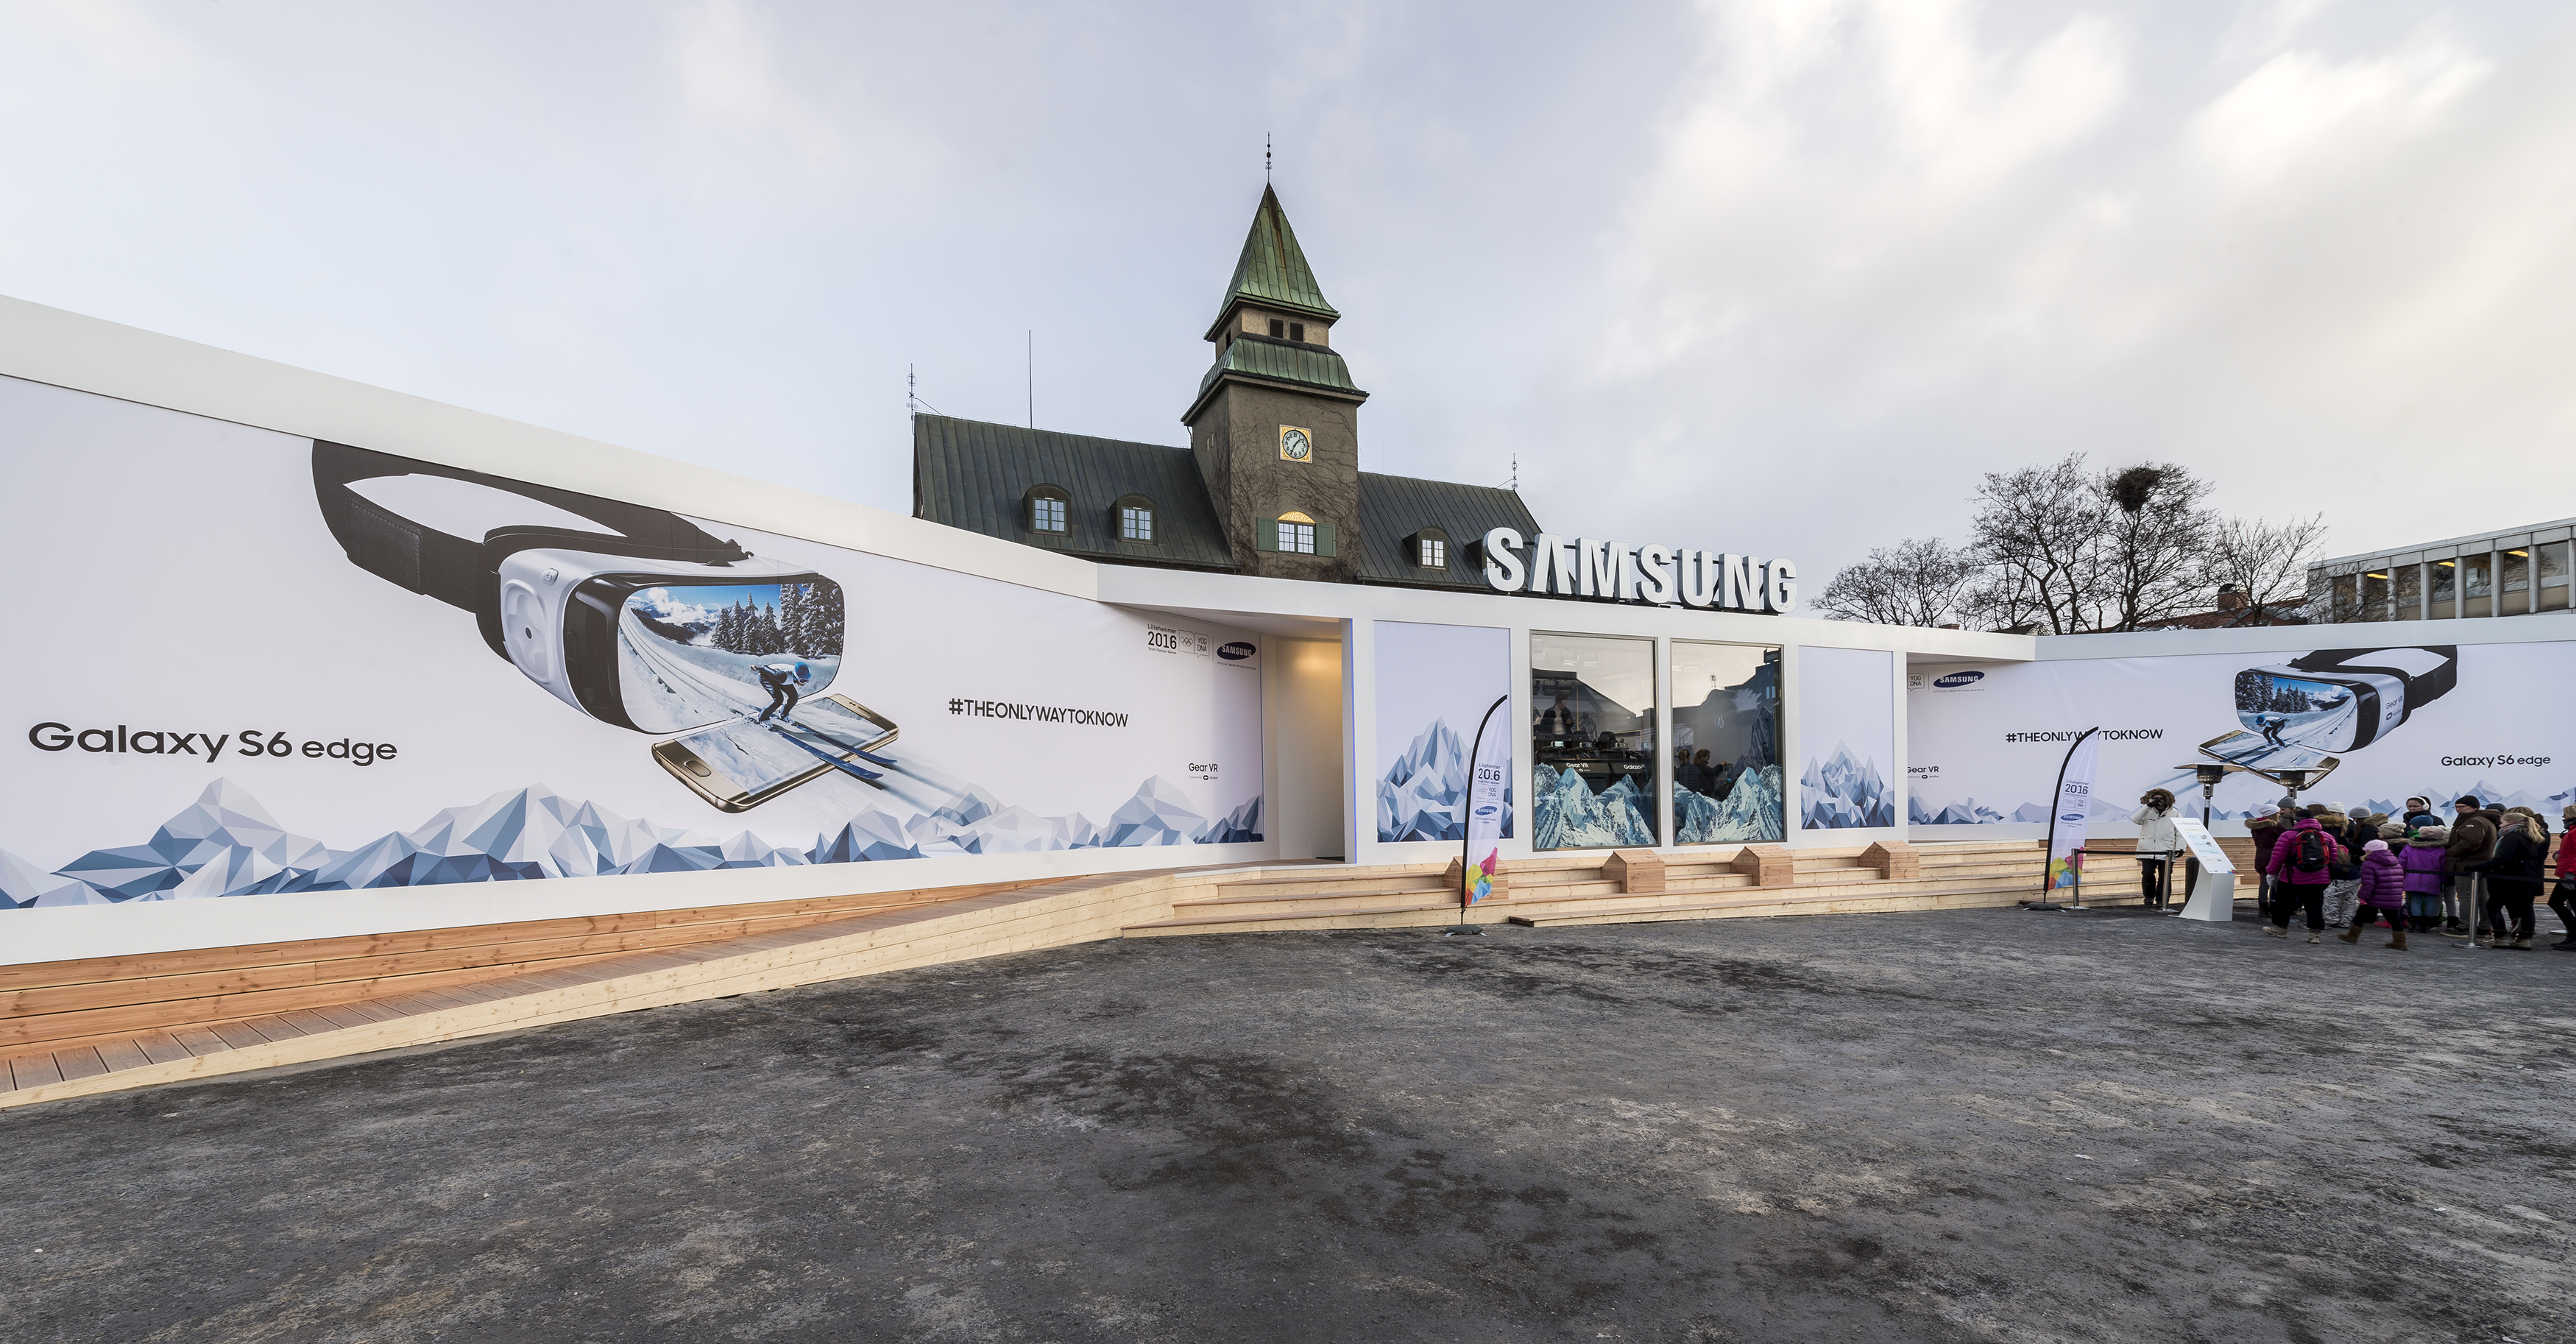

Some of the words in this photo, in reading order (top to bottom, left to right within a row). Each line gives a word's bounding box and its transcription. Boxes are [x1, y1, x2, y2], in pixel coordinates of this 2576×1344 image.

[1483, 527, 1797, 613] SAMSUNG
[1147, 623, 1176, 634] Lillehammer
[1147, 631, 1177, 649] 2016
[1197, 637, 1207, 645] YOG
[1197, 644, 1207, 652] DNA
[1221, 645, 1252, 657] SAMSUNG
[949, 698, 1128, 727] #THEONLYWAYTOKNOW
[2006, 729, 2163, 743] #THEONLYWYTOKNOW
[29, 721, 229, 763] Galaxy
[238, 729, 293, 757] S6
[301, 738, 397, 767] edge
[1189, 763, 1208, 771] Gear
[1209, 763, 1218, 772] VR
[2441, 755, 2495, 768] Galaxy
[2497, 754, 2515, 765] S6
[2517, 756, 2551, 767] edge
[2064, 783, 2088, 795] 2016
